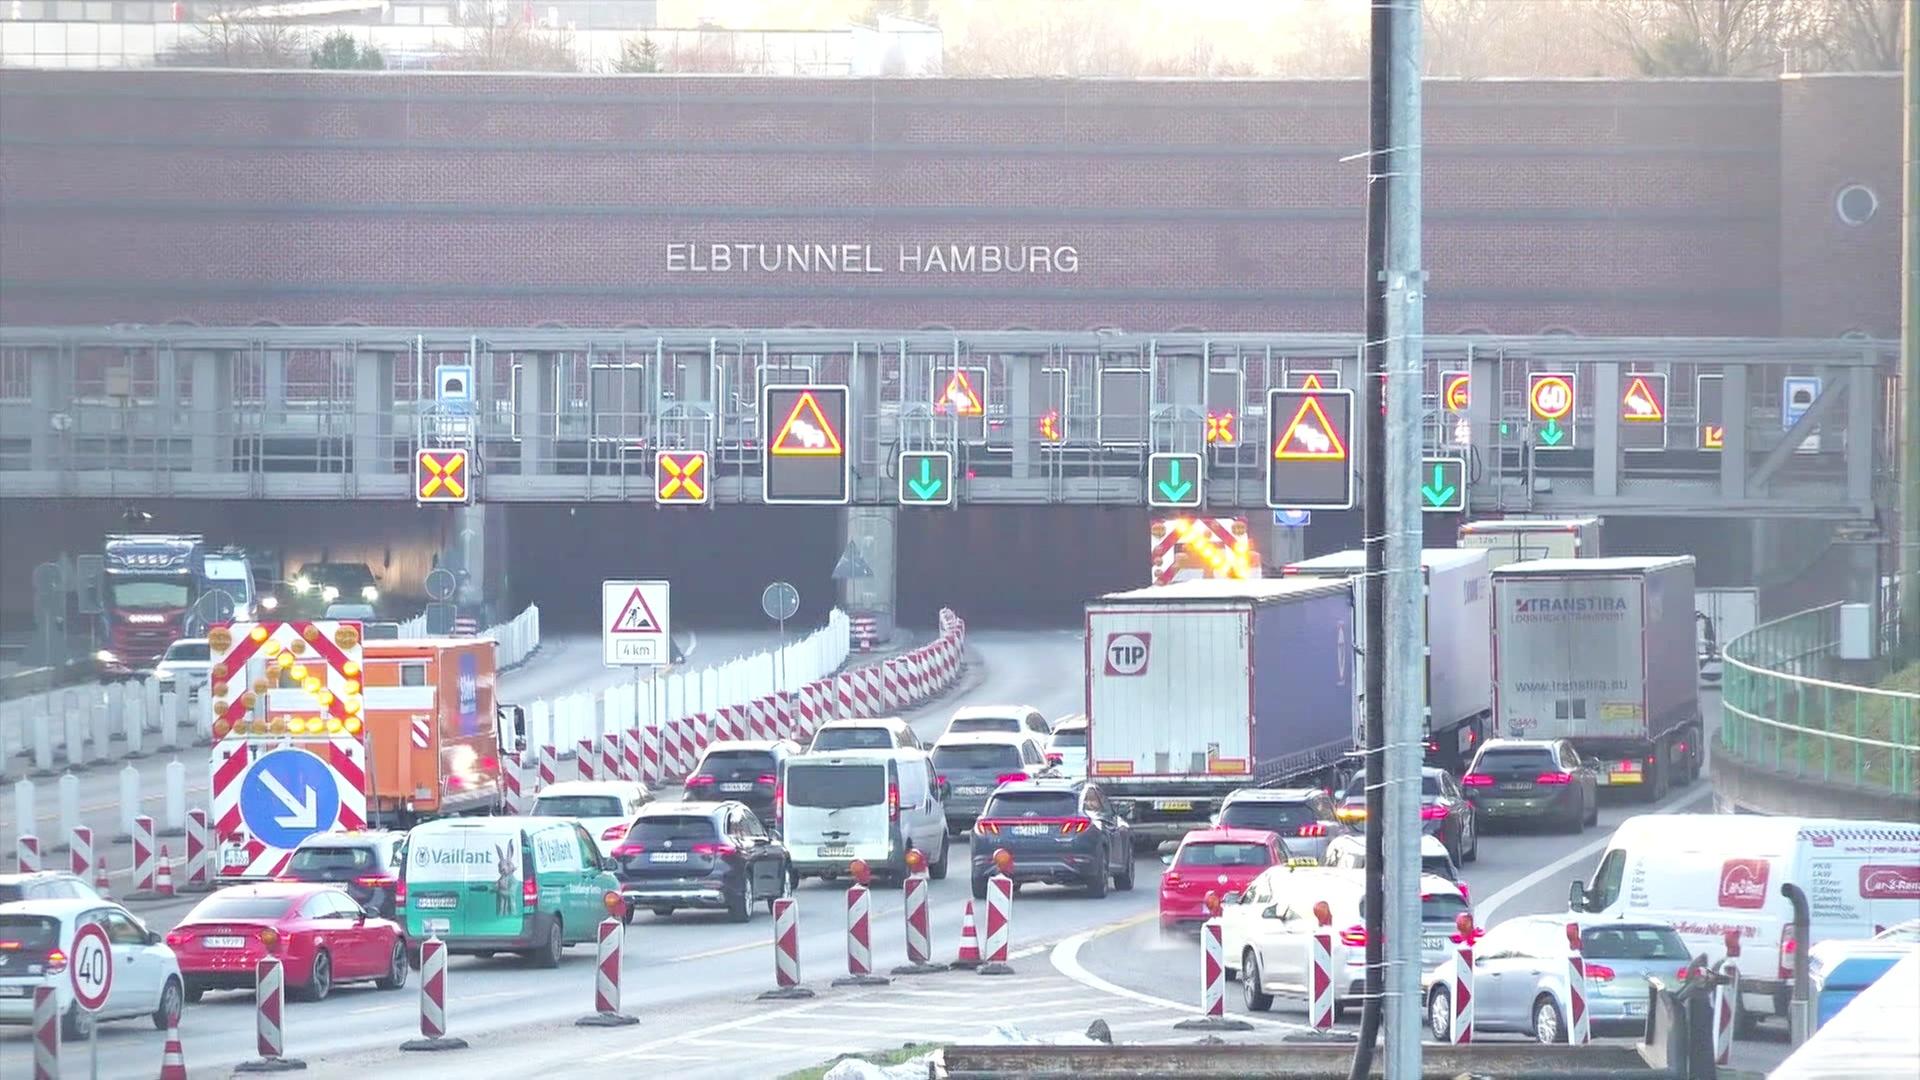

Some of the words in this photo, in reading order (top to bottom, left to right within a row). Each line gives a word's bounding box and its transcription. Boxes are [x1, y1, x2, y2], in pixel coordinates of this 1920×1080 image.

[665, 243, 883, 273] ELBTUNNEL
[899, 244, 1080, 273] HAMBURG
[1539, 386, 1565, 409] 60
[623, 644, 630, 655] 4
[633, 644, 650, 655] km
[1111, 646, 1145, 665] TIP
[432, 849, 493, 865] Vaillant
[79, 947, 103, 984] 40
